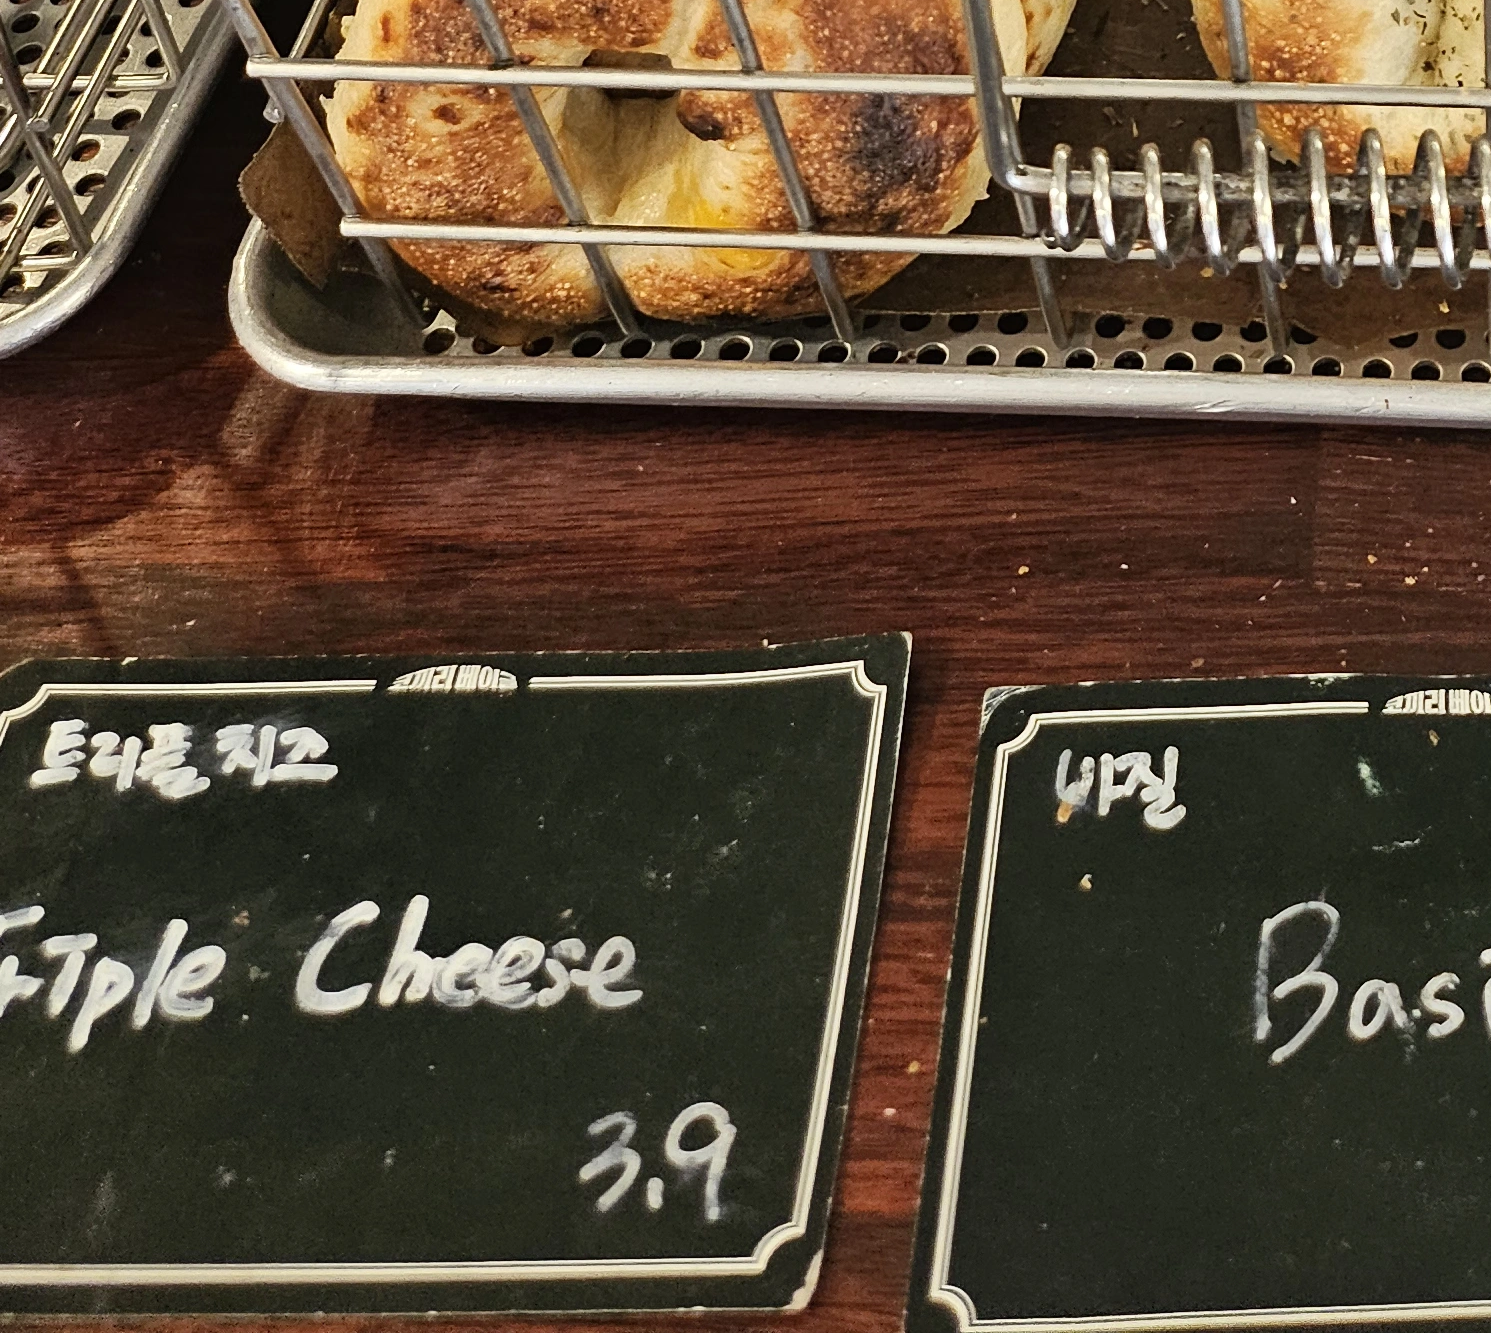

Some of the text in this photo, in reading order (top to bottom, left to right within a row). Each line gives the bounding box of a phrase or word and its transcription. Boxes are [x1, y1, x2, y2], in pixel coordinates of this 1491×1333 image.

[30, 718, 338, 799] 트리플 치즈
[1055, 745, 1187, 830] 바질
[296, 894, 643, 1015] Cheese
[578, 1101, 737, 1221] 3.9
